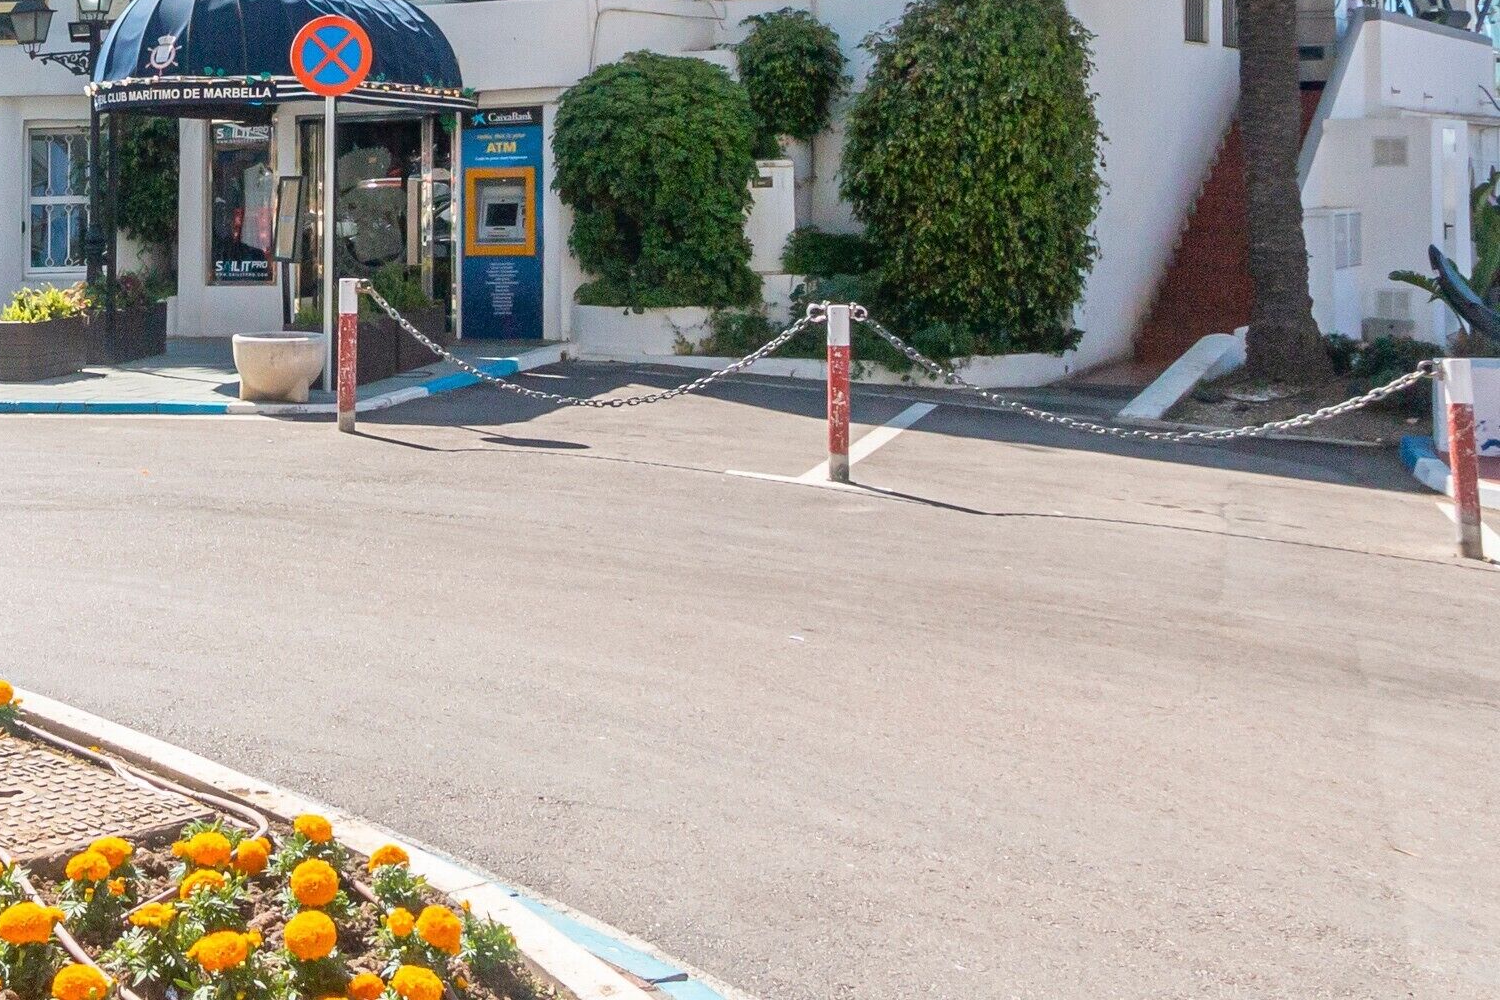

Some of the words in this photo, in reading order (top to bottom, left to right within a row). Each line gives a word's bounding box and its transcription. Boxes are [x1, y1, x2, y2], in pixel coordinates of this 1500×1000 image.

[108, 91, 127, 103] CLUB
[129, 87, 179, 101] MARÍTIMO
[183, 88, 200, 99] DE
[203, 87, 271, 98] MARBELLA
[488, 111, 532, 122] CaixaBank
[486, 141, 517, 153] ATM
